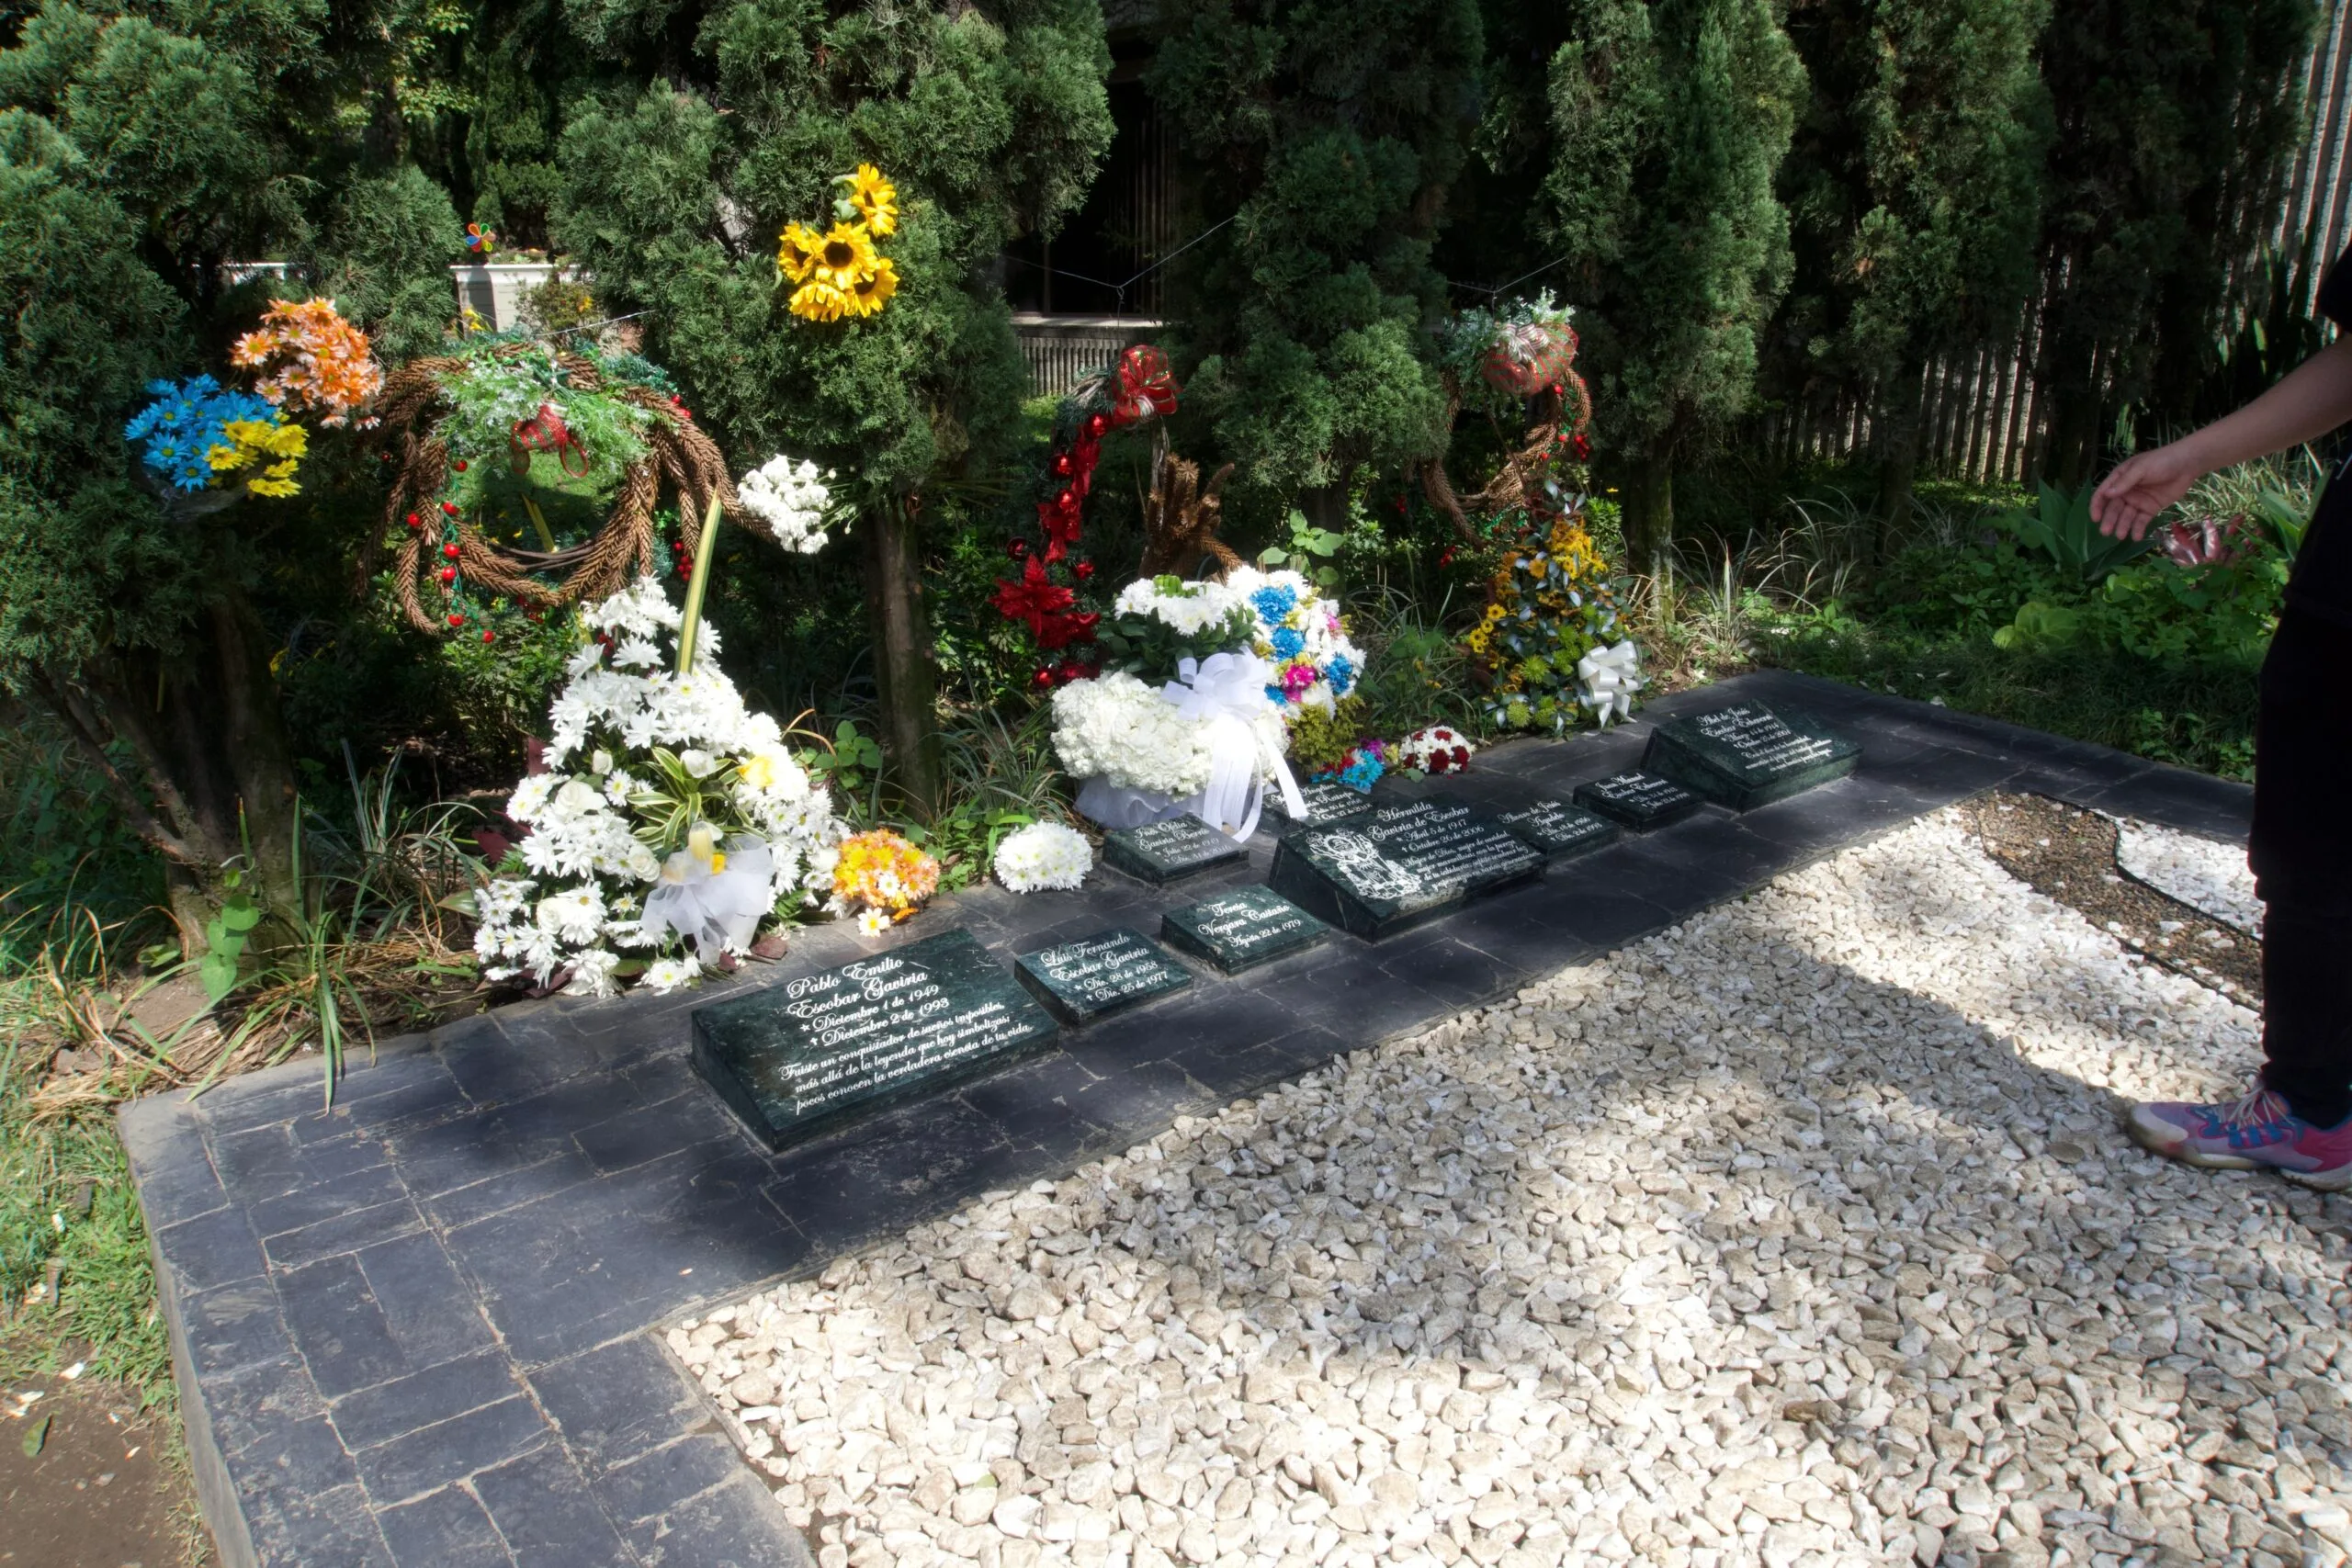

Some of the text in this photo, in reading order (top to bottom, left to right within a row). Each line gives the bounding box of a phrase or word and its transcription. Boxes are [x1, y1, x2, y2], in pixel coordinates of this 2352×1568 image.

[1367, 807, 1470, 841] Gaviria de Escobar
[1377, 801, 1433, 821] Hermilda
[1136, 836, 1175, 852] Gaviria
[1408, 839, 1441, 852] Octubre
[1453, 831, 1462, 840] de
[1437, 825, 1446, 833] de
[1208, 901, 1248, 917] Teresa
[1197, 919, 1248, 936] Vergara
[1259, 928, 1272, 938] 22
[1272, 926, 1282, 934] de
[1282, 919, 1302, 931] 1979
[1040, 933, 1131, 968] Luis Fernando
[1050, 947, 1150, 981] Escobar Gaviria
[786, 956, 905, 999] Pablo Emilio
[1083, 976, 1109, 991] Dic.
[1109, 972, 1124, 984] 28
[1124, 969, 1134, 978] de
[1095, 970, 1169, 1002] Dic. 25 de 1977
[786, 971, 928, 1019] Escobar Gaviria
[812, 985, 940, 1032] Diciembre 1 de 1949
[821, 998, 950, 1047] Diciembre 2 de 1993
[779, 1062, 819, 1081] Fuiste
[820, 1056, 837, 1068] un
[838, 1033, 906, 1063] conquistador
[907, 1027, 921, 1039] de
[921, 1018, 955, 1036] sueños
[795, 1077, 820, 1093] más
[820, 1067, 844, 1085] allá
[845, 1064, 860, 1076] de
[861, 1060, 874, 1071] la
[874, 1045, 917, 1069] leyenda
[918, 1039, 936, 1055] que
[936, 1033, 956, 1047] hoy
[796, 1093, 826, 1116] pocos
[828, 1077, 873, 1100] conocen
[874, 1072, 888, 1084] la
[888, 1054, 943, 1078] verdadera
[981, 1033, 994, 1046] de
[995, 1032, 1009, 1042] tu
